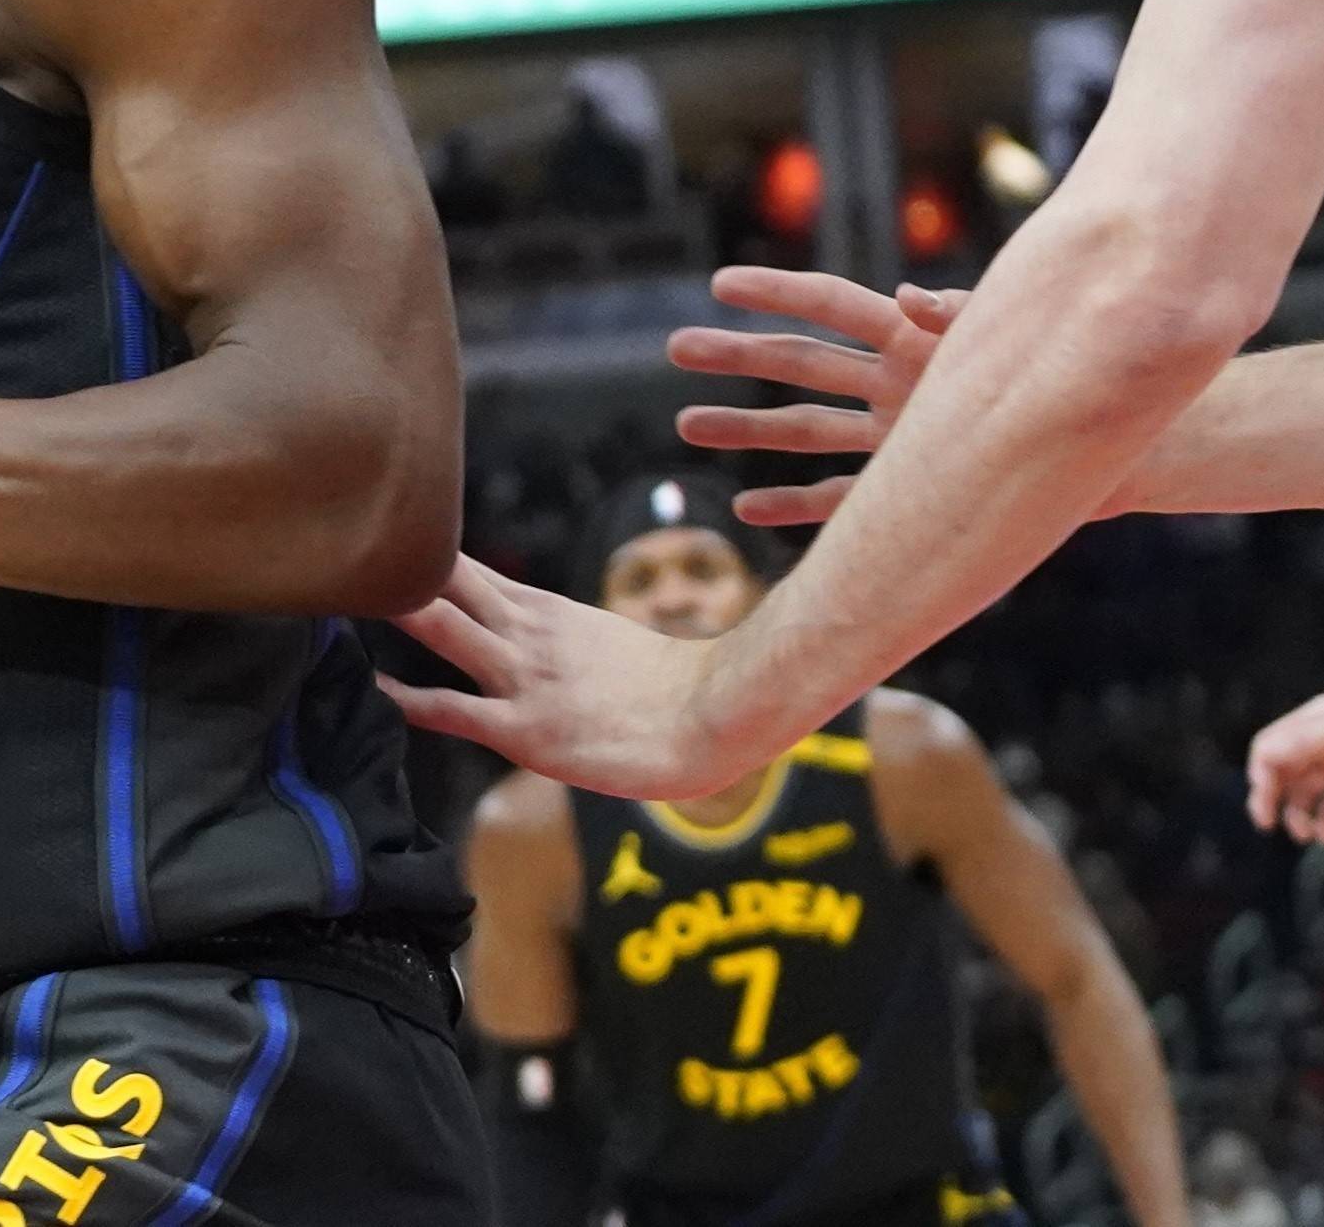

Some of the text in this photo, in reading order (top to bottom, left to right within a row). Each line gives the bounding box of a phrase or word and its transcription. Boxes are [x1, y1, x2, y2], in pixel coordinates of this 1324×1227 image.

[618, 879, 863, 982] GOLDEN
[711, 946, 779, 1057] 7
[679, 1033, 860, 1118] STATE
